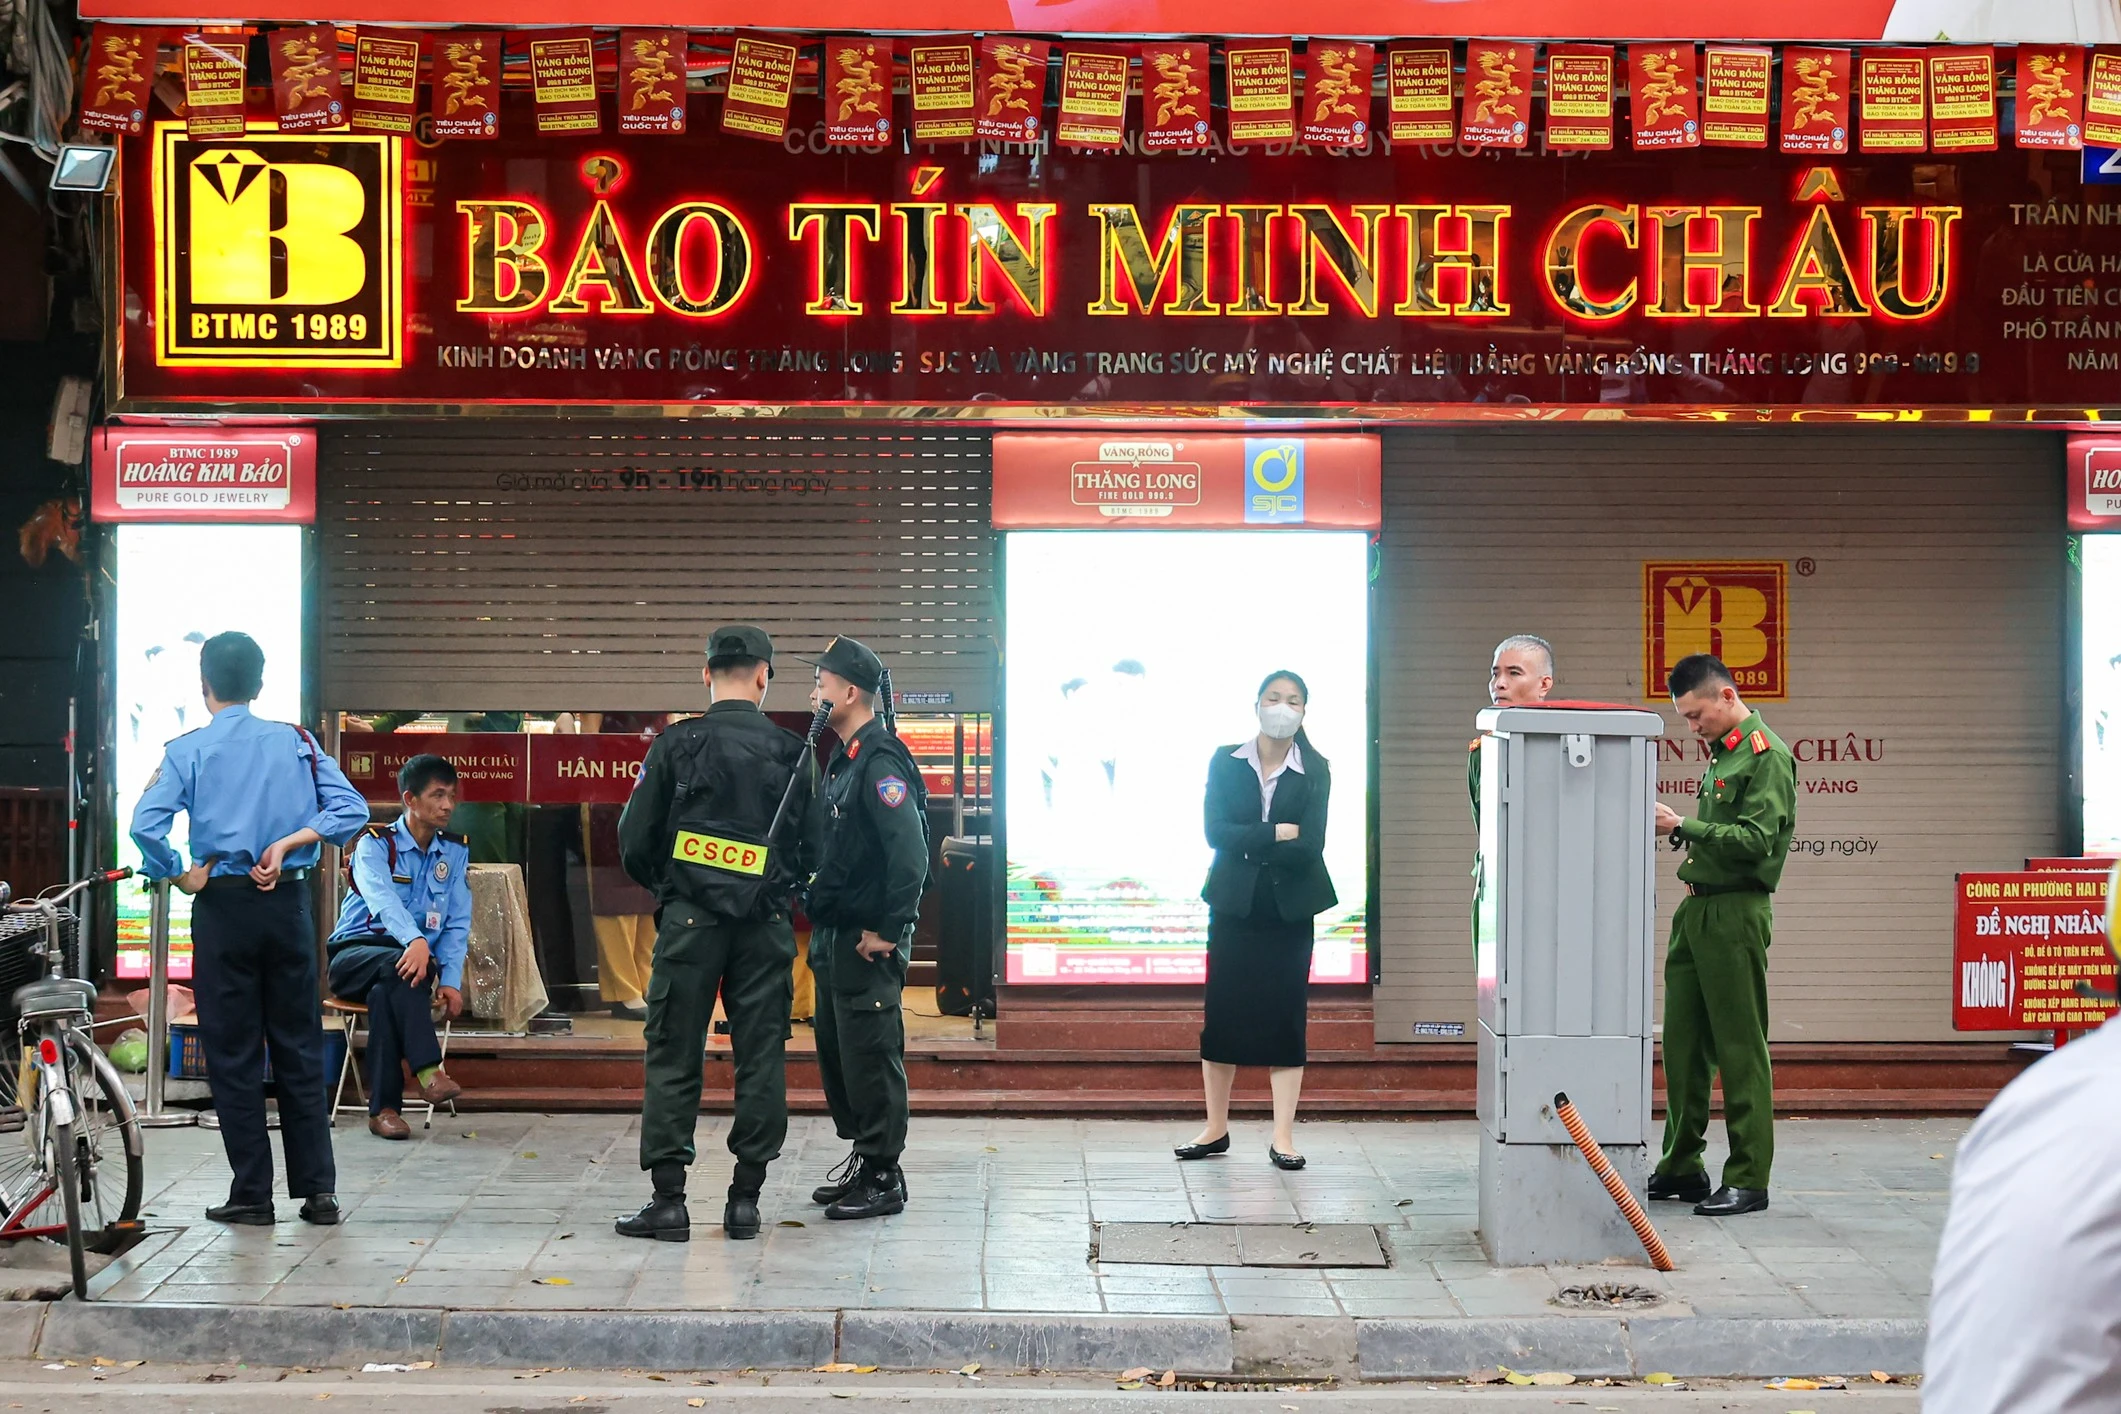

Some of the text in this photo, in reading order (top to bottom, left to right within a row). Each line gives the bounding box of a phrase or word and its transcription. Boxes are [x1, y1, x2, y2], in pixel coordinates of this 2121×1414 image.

[536, 57, 562, 67] VÀNG
[916, 64, 942, 74] VÀNG
[537, 67, 590, 78] THĂNG LONG
[1233, 67, 1259, 76] VÀNG
[1554, 72, 1579, 81] VÀNG
[916, 75, 970, 85] THĂNG LONG
[1234, 77, 1287, 86] THĂNG LONG
[1867, 75, 1892, 84] VÀNG
[1554, 82, 1607, 92] THĂNG LONG
[1867, 86, 1920, 95] THĂNG LONG
[282, 117, 328, 129] QUỐC TẾ
[1148, 136, 1193, 145] QUỐC TẾ
[1783, 141, 1813, 149] QUỐC
[456, 155, 1962, 319] BẢO TÍN MINH CHÂU
[2023, 251, 2049, 272] LÀ
[2054, 249, 2094, 273] CỬA
[2002, 281, 2045, 306] ĐẦU
[2053, 284, 2099, 306] TIÊN
[191, 313, 367, 340] BTMC 1989
[2004, 315, 2110, 339] PHỐ TRẦN
[438, 346, 493, 368] KINH
[500, 346, 585, 369] DOANH
[594, 343, 660, 370] VÀNG
[750, 344, 827, 372] THĂNG
[839, 351, 903, 373] LONG
[920, 351, 960, 373] SJC
[971, 347, 1000, 374] VÀ
[1010, 347, 1076, 374] VÀNG
[1085, 352, 1163, 374] TRANG
[1170, 347, 1216, 375] SỨC
[1224, 348, 1258, 375] MỸ
[1268, 347, 1334, 380] NGHỆ
[1341, 346, 1403, 375] CHẤT
[1411, 348, 1461, 380] LIỆU
[1469, 344, 1536, 375] BẰNG
[1544, 345, 1608, 375] VÀNG
[1615, 344, 1682, 375] RỒNG
[1690, 348, 1773, 375] THĂNG
[1781, 353, 1847, 375] LONG
[2067, 348, 2118, 370] NĂM
[170, 448, 239, 459] BTMC 1989
[1104, 445, 1135, 457] VÀNG
[123, 457, 283, 483] HOÀNG KIM BẢO
[619, 467, 650, 492] 9h
[678, 467, 722, 492] 19h
[783, 472, 832, 497] ngày
[1074, 469, 1196, 489] THĂNG LONG
[137, 492, 269, 503] PURE GOLD JEWELRY
[1098, 492, 1118, 500] FINE
[1122, 492, 1144, 500] GOLD
[1252, 495, 1297, 517] SJC
[1737, 671, 1768, 685] 989
[1793, 732, 1884, 762] CHÂU
[481, 754, 520, 767] CHÂU
[557, 756, 604, 779] HÂN
[472, 768, 487, 779] GIỮ
[490, 769, 513, 780] VÀNG
[1807, 776, 1858, 793] VÀNG
[683, 838, 757, 867] CSCĐ
[1831, 837, 1878, 856] ngày
[1966, 880, 2000, 898] CÔNG
[2003, 883, 2020, 897] AN
[2023, 880, 2072, 897] PHƯỜNG
[2076, 882, 2096, 896] HAI
[1976, 906, 2106, 940] ĐỀ NGHỊ NHÂN
[1962, 953, 2007, 1008] KHÔNG
